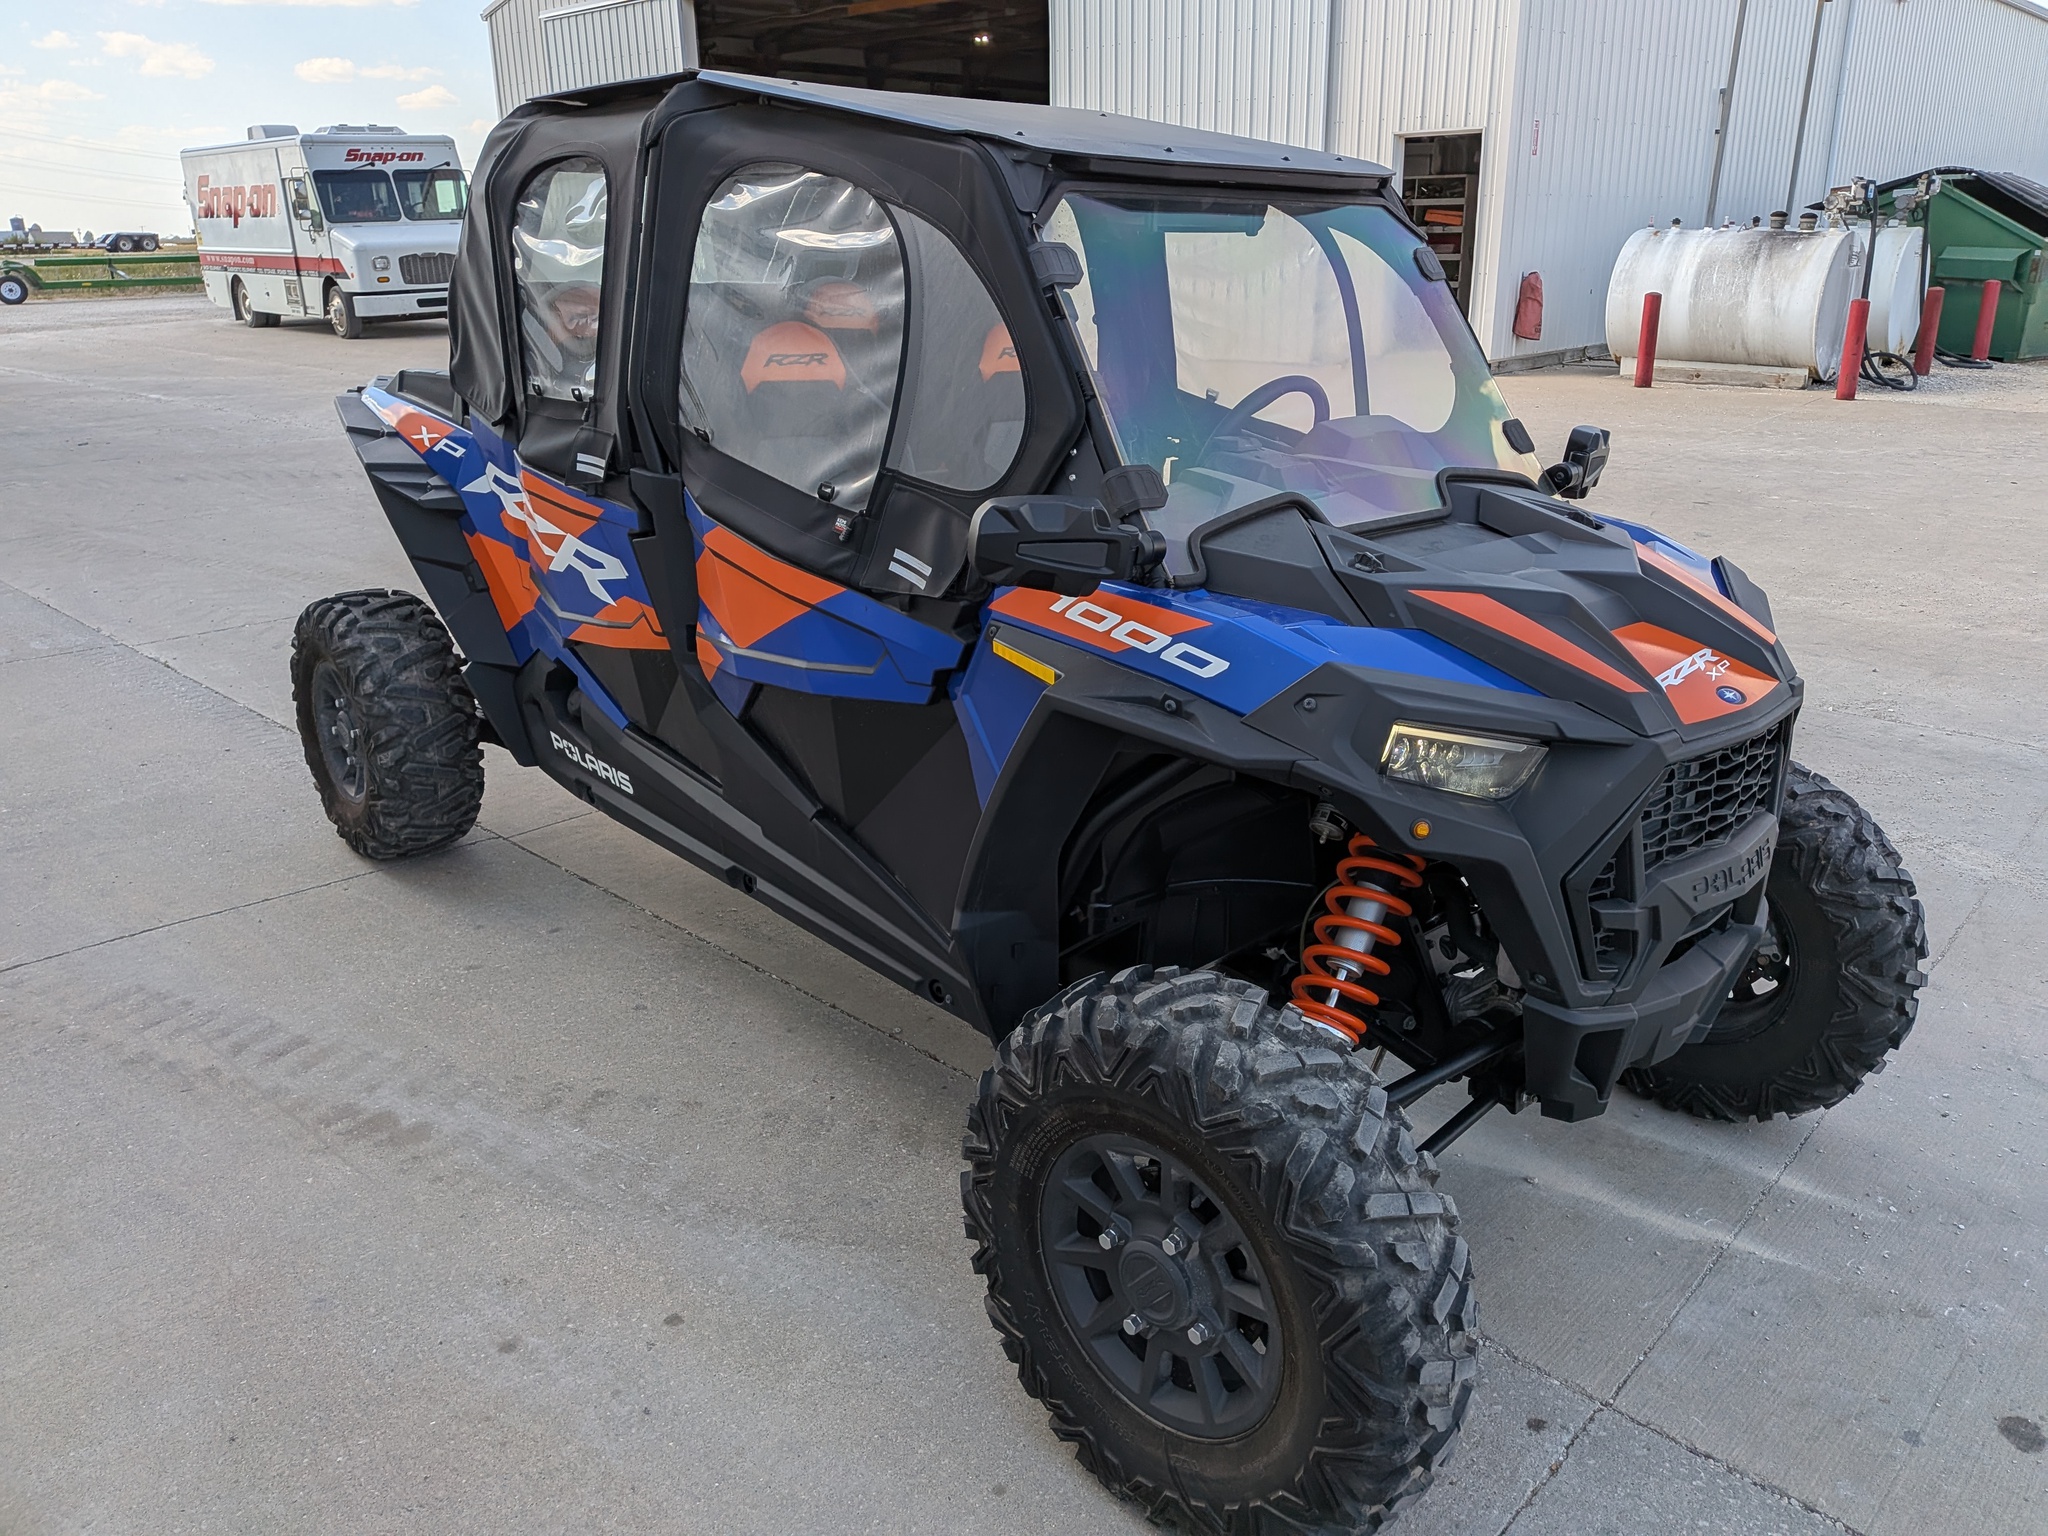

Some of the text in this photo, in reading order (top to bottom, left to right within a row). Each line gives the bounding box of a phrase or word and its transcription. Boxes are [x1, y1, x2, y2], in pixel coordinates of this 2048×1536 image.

[344, 148, 425, 165] Snap-on
[197, 174, 276, 229] Snap-on
[763, 352, 829, 369] RZR
[410, 425, 466, 458] XP
[461, 461, 629, 607] RZR
[1048, 594, 1230, 679] 1000
[1654, 647, 1721, 693] RZR
[1705, 659, 1731, 682] XP
[549, 730, 634, 795] POLARIS
[1692, 837, 1771, 903] POLARIS
